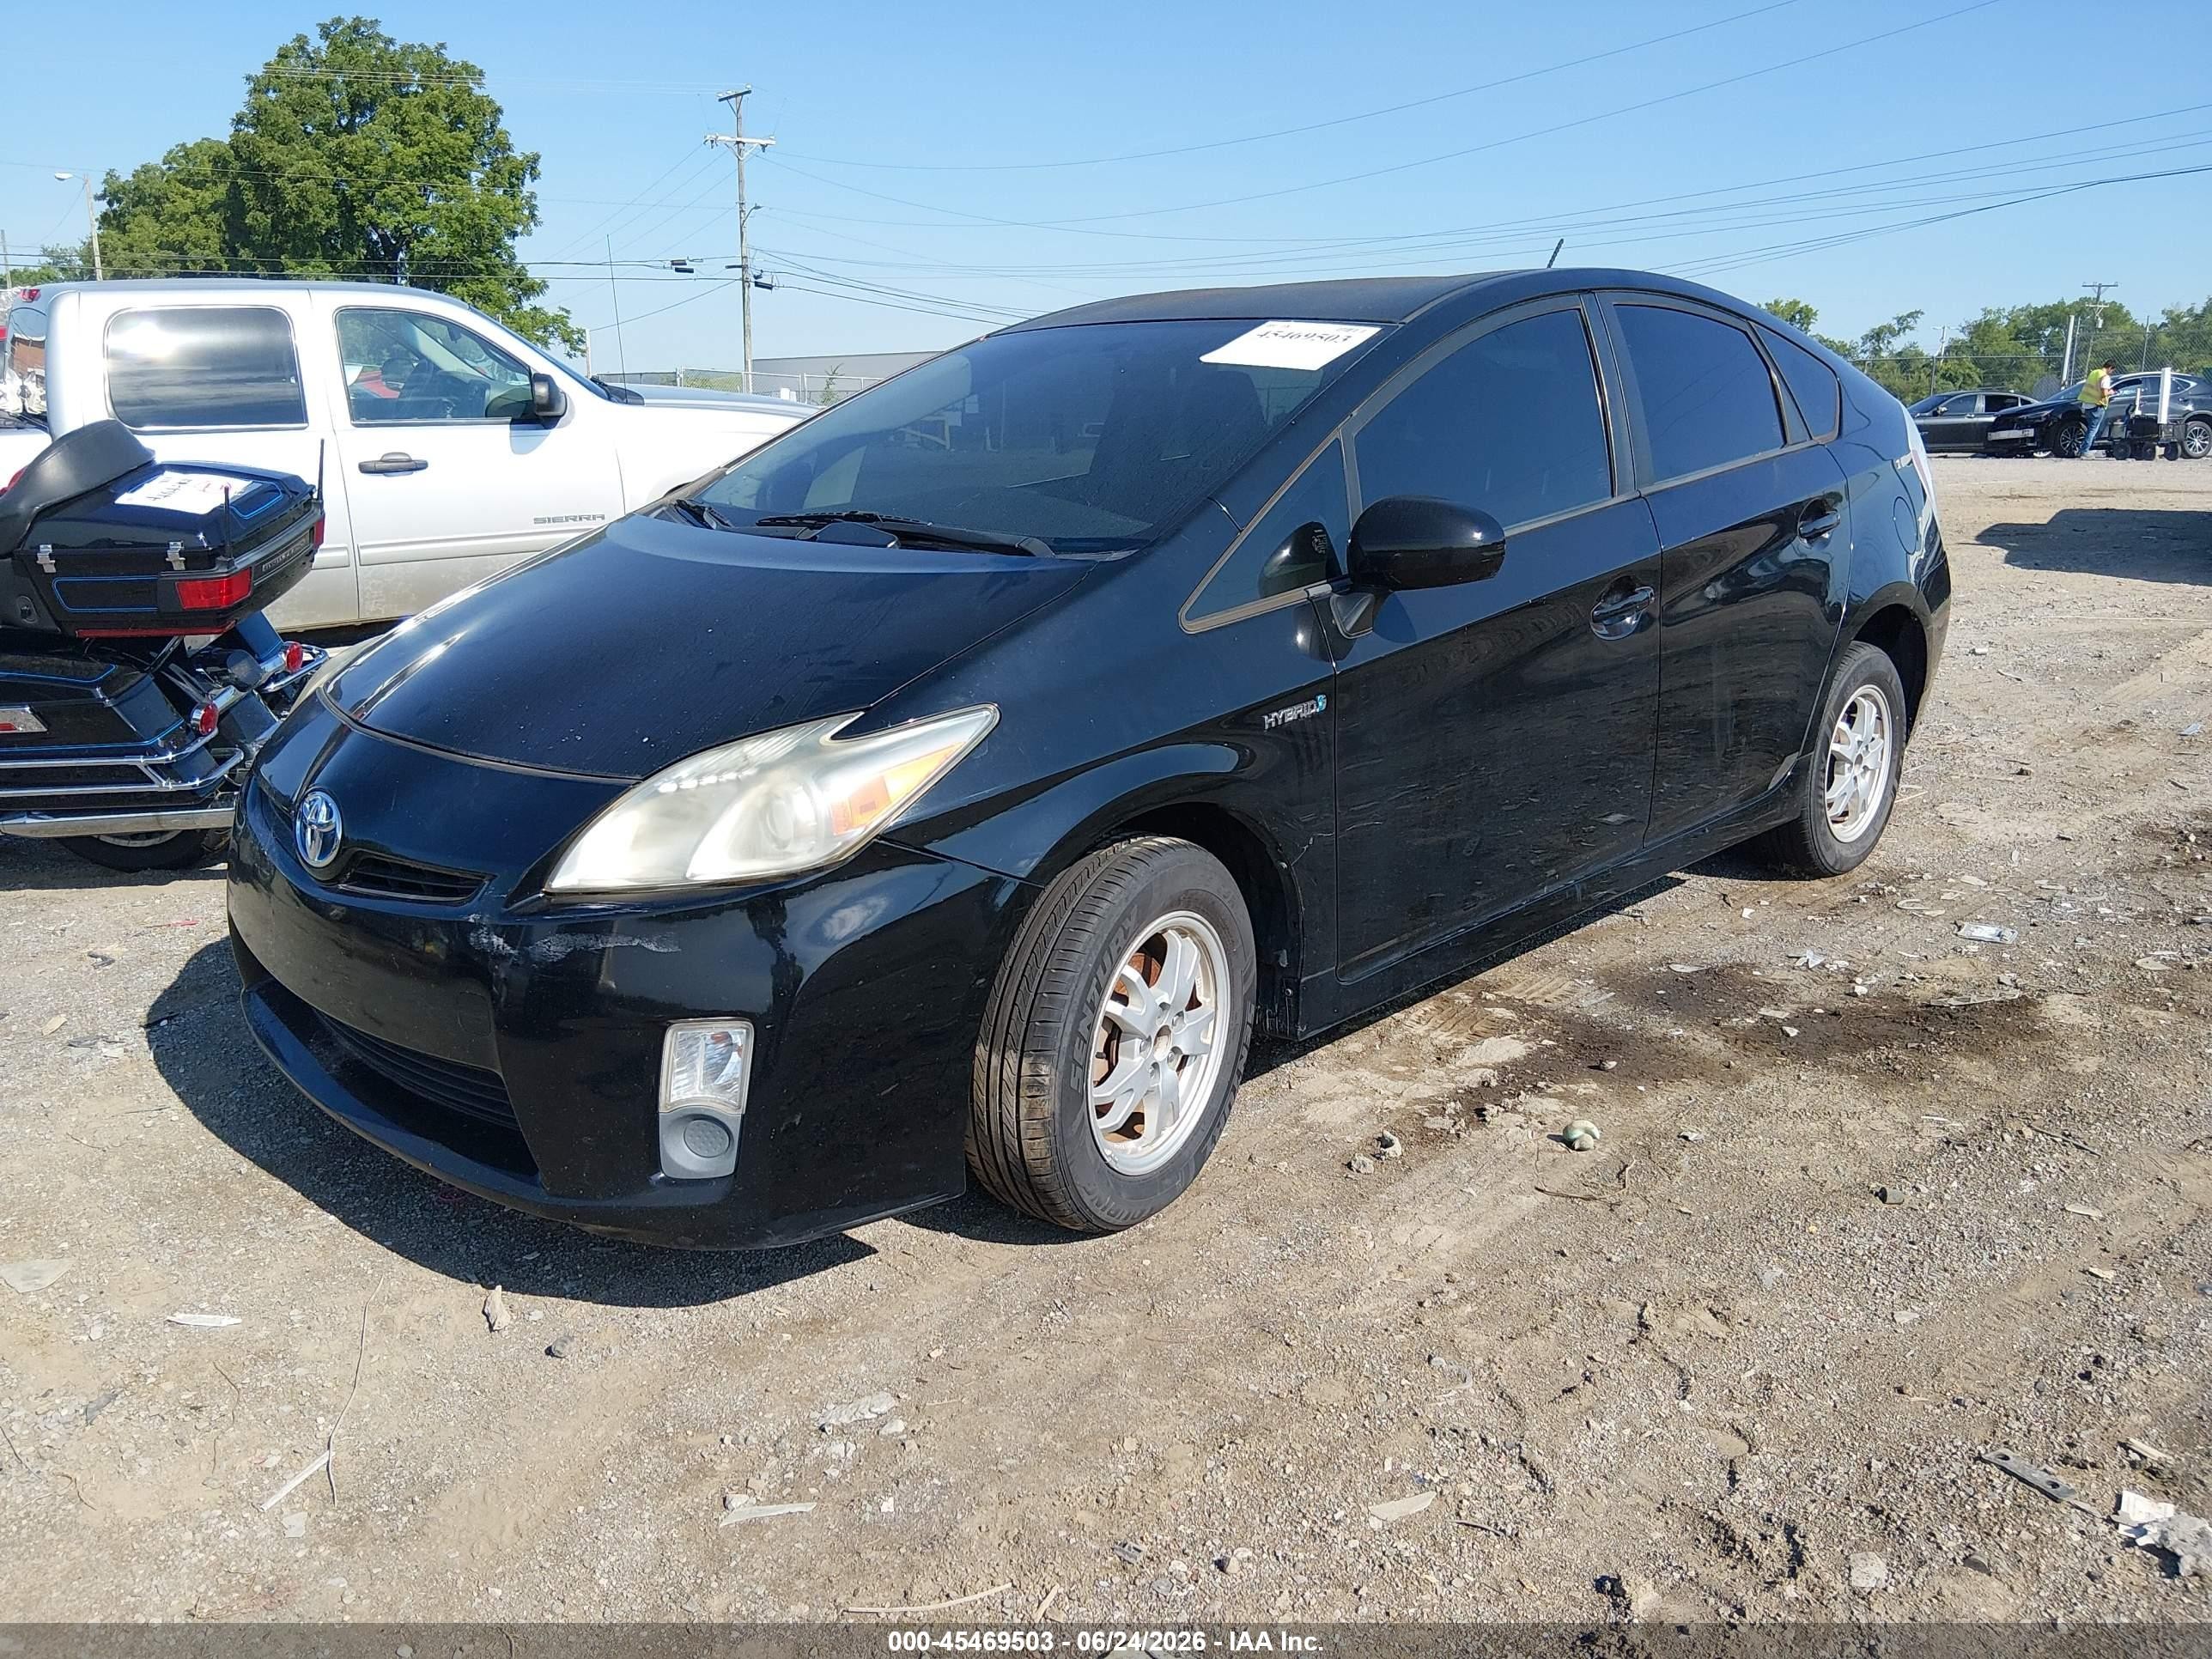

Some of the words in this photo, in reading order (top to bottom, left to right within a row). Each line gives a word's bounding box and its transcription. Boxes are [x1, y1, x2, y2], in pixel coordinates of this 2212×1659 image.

[532, 514, 605, 525] SIERRA
[1262, 699, 1317, 730] HYBRID
[1070, 904, 1139, 1095] SENTURY
